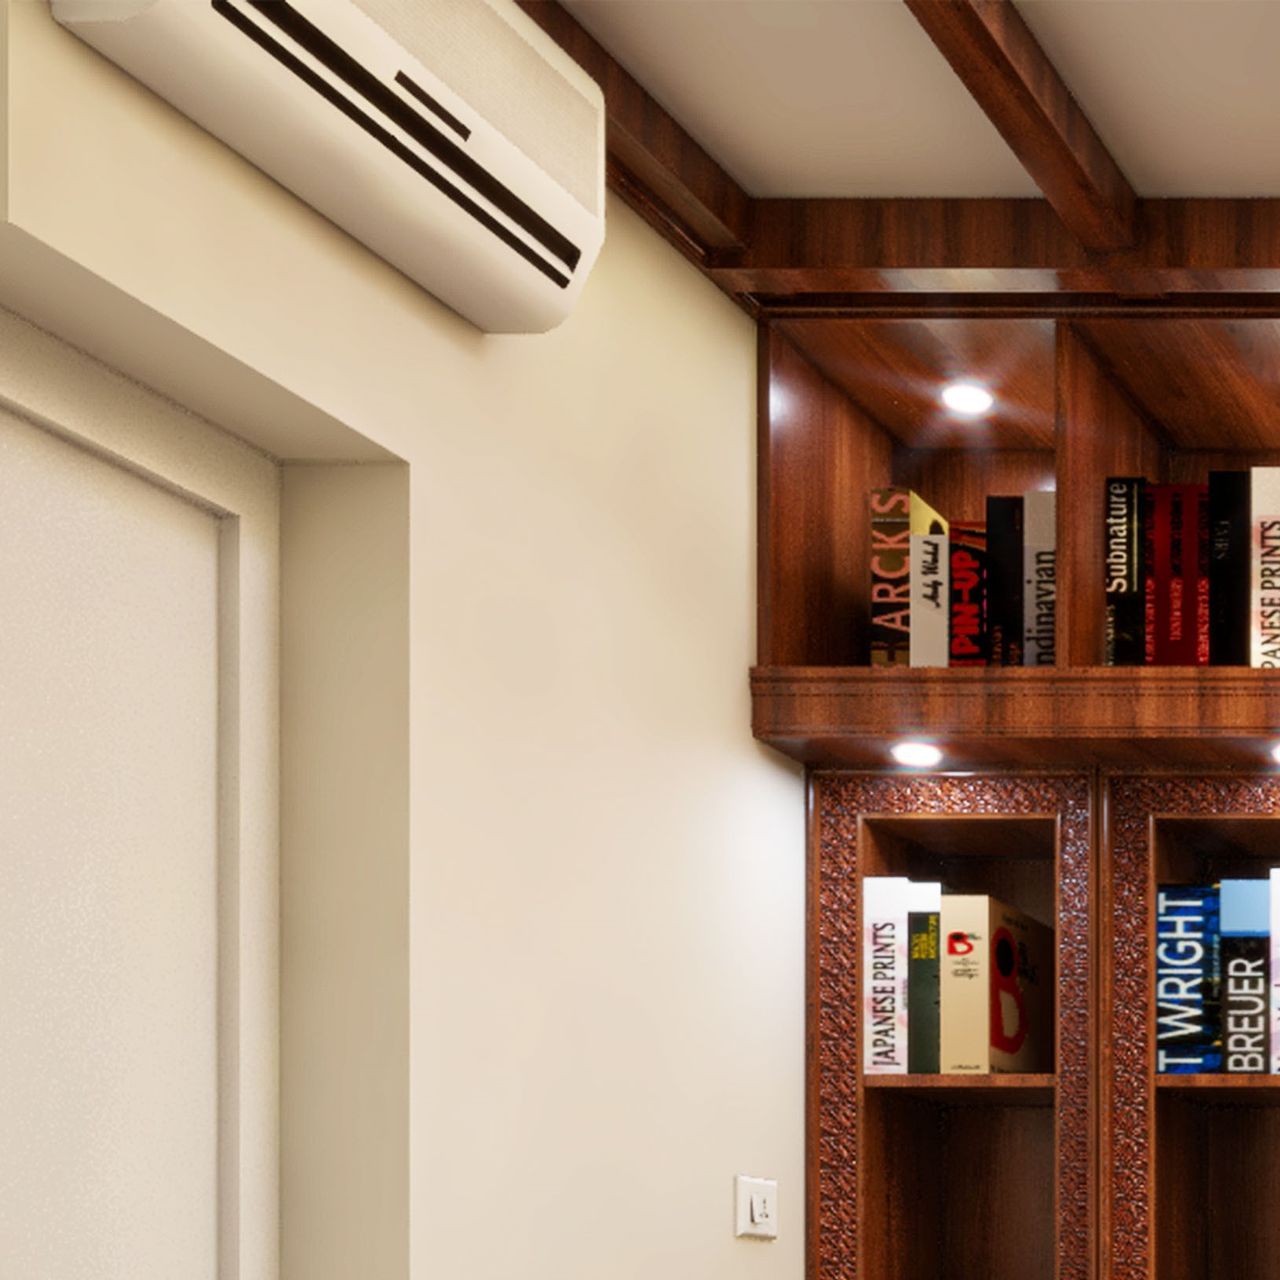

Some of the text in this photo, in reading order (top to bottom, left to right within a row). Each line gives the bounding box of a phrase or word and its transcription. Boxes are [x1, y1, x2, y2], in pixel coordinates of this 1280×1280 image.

[1106, 483, 1127, 592] Subnature
[951, 550, 982, 655] PIN-UP
[872, 922, 900, 1065] JAPANESE PRINTS
[1157, 893, 1204, 1039] WRIGHT
[1227, 958, 1265, 1072] BREUER
